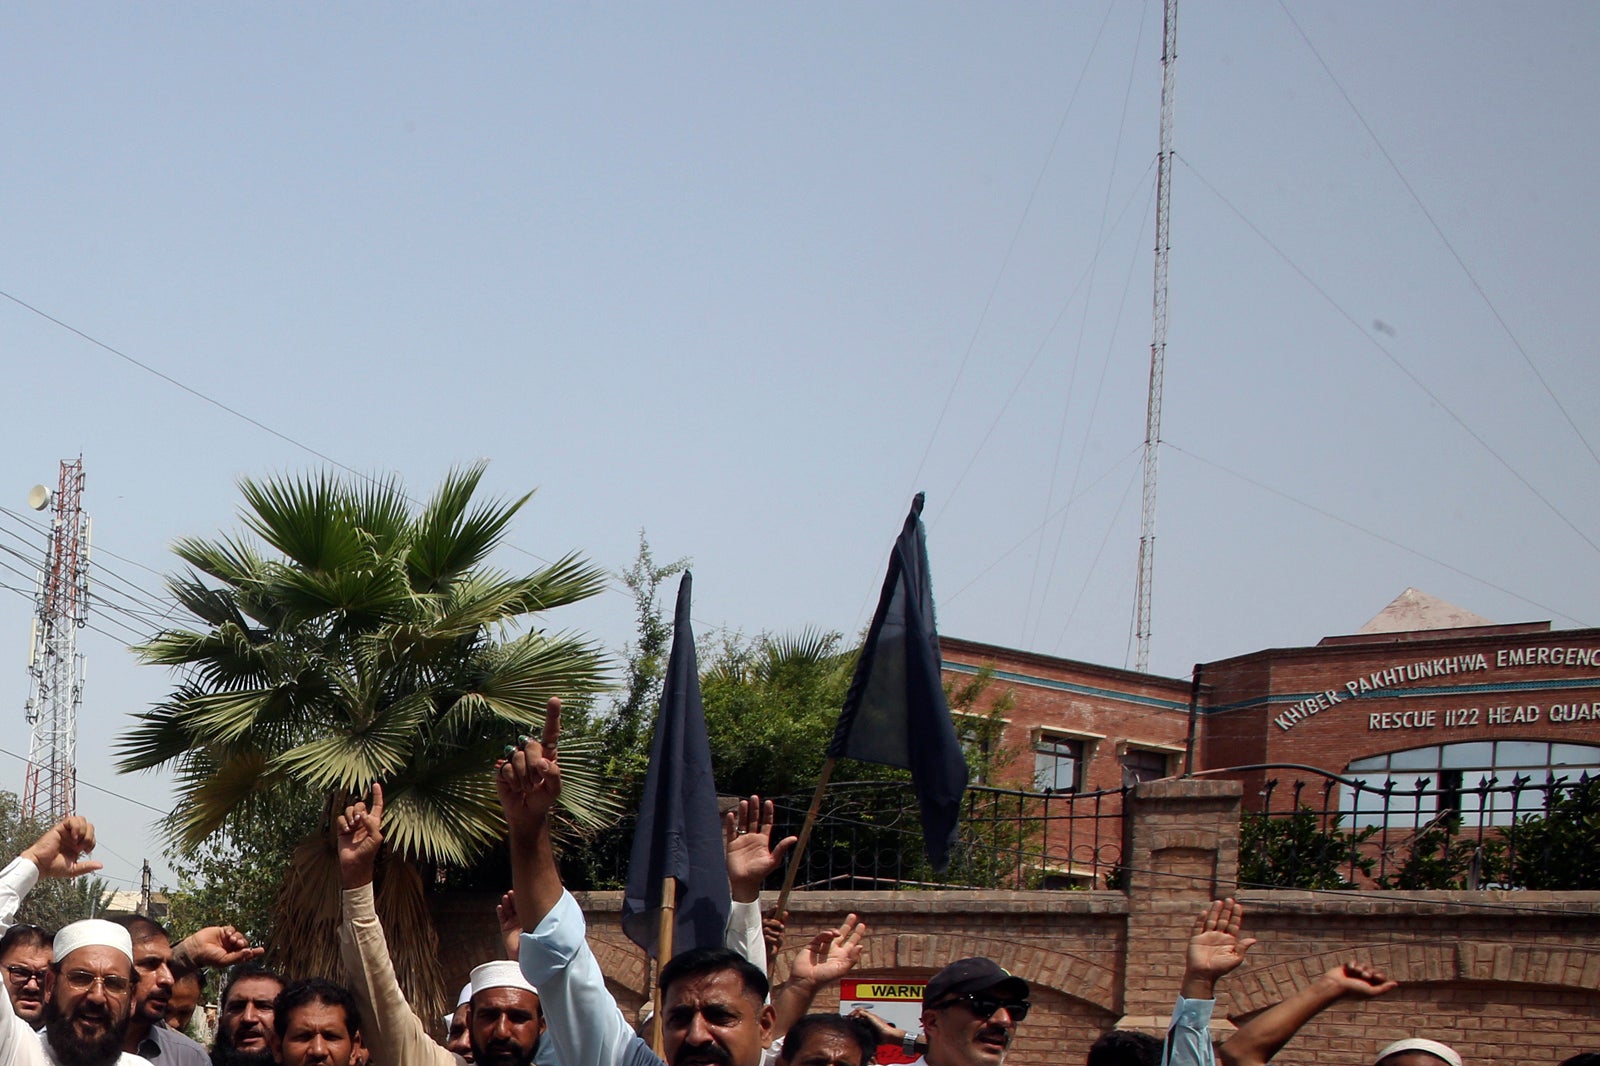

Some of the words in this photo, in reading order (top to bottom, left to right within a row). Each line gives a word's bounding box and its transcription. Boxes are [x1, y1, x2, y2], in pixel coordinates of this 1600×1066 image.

[1274, 689, 1342, 731] KHYBER
[1345, 653, 1488, 697] PAKHTUNKHWA
[1497, 647, 1600, 667] EMERGENC
[1369, 710, 1436, 730] RESCUE
[1445, 708, 1479, 727] 1122
[1488, 705, 1540, 724] HEAD
